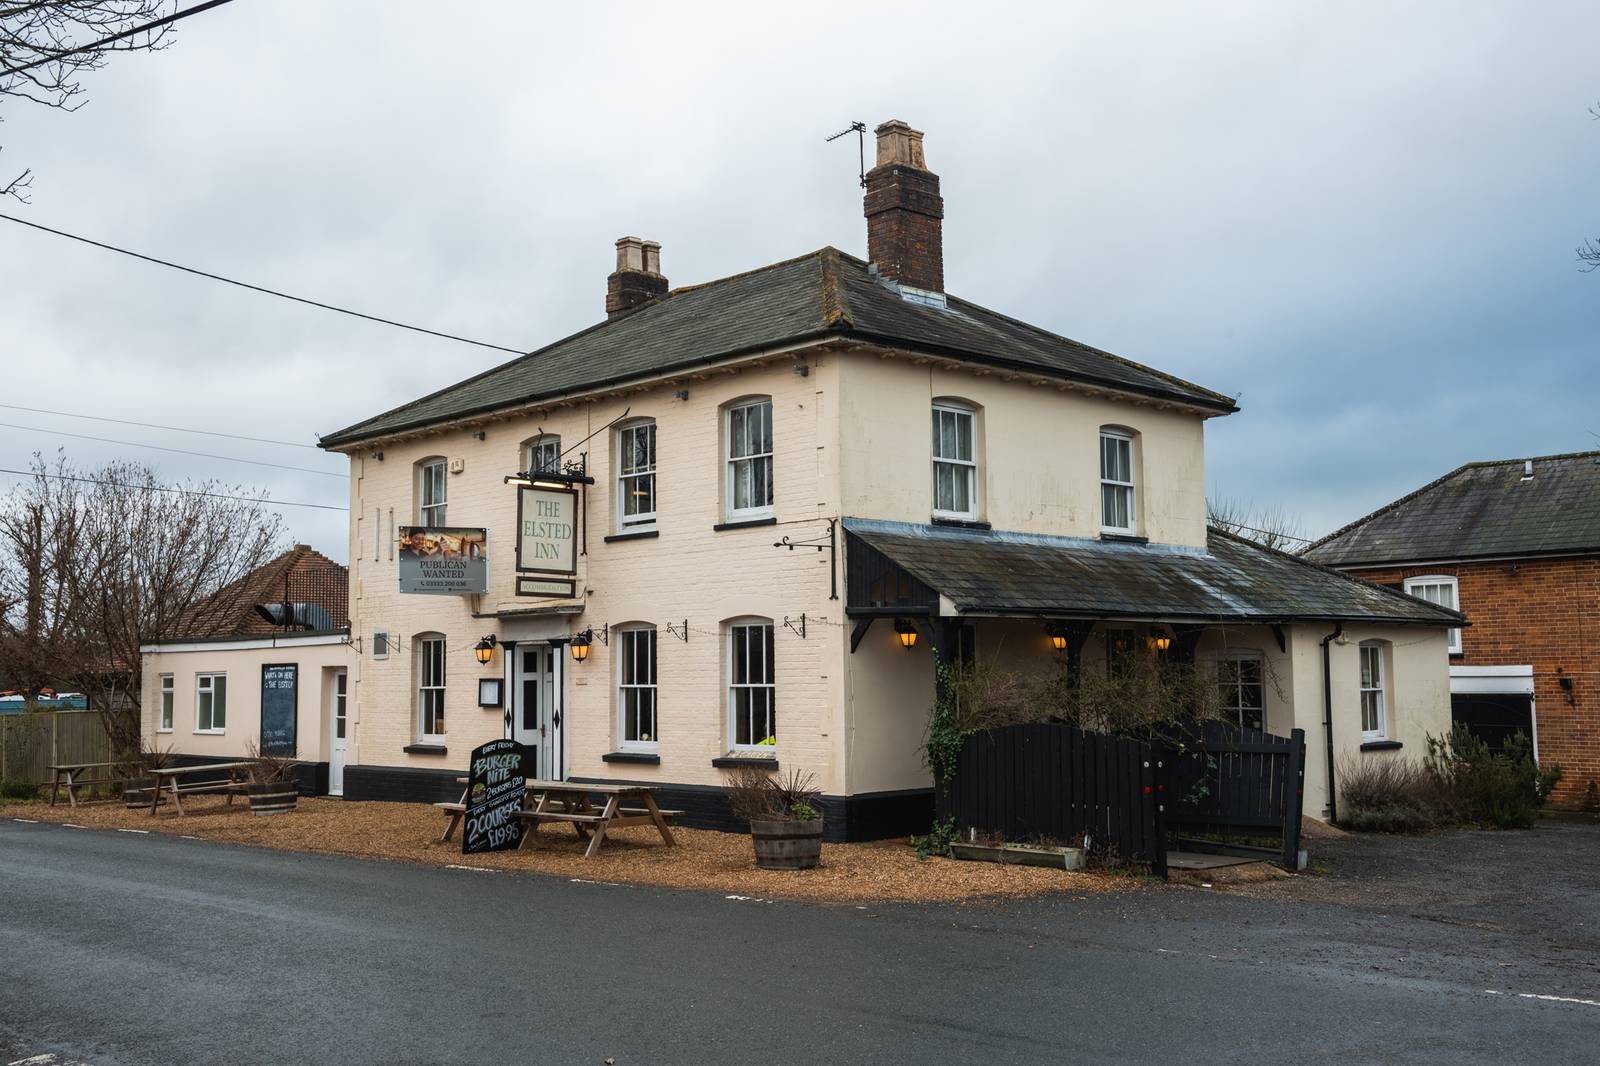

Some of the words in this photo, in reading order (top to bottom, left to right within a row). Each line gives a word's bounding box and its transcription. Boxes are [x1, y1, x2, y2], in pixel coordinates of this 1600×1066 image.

[536, 500, 560, 518] THE
[523, 520, 572, 540] ELSTED
[534, 541, 560, 560] INN
[420, 560, 467, 569] PUBLICAN
[423, 569, 465, 578] WANTED
[482, 743, 496, 754] EVERY
[473, 753, 522, 778] BURGER
[512, 776, 523, 788] £20
[467, 818, 479, 844] 2
[477, 798, 521, 834] COURSES
[487, 820, 520, 848] £19.95
